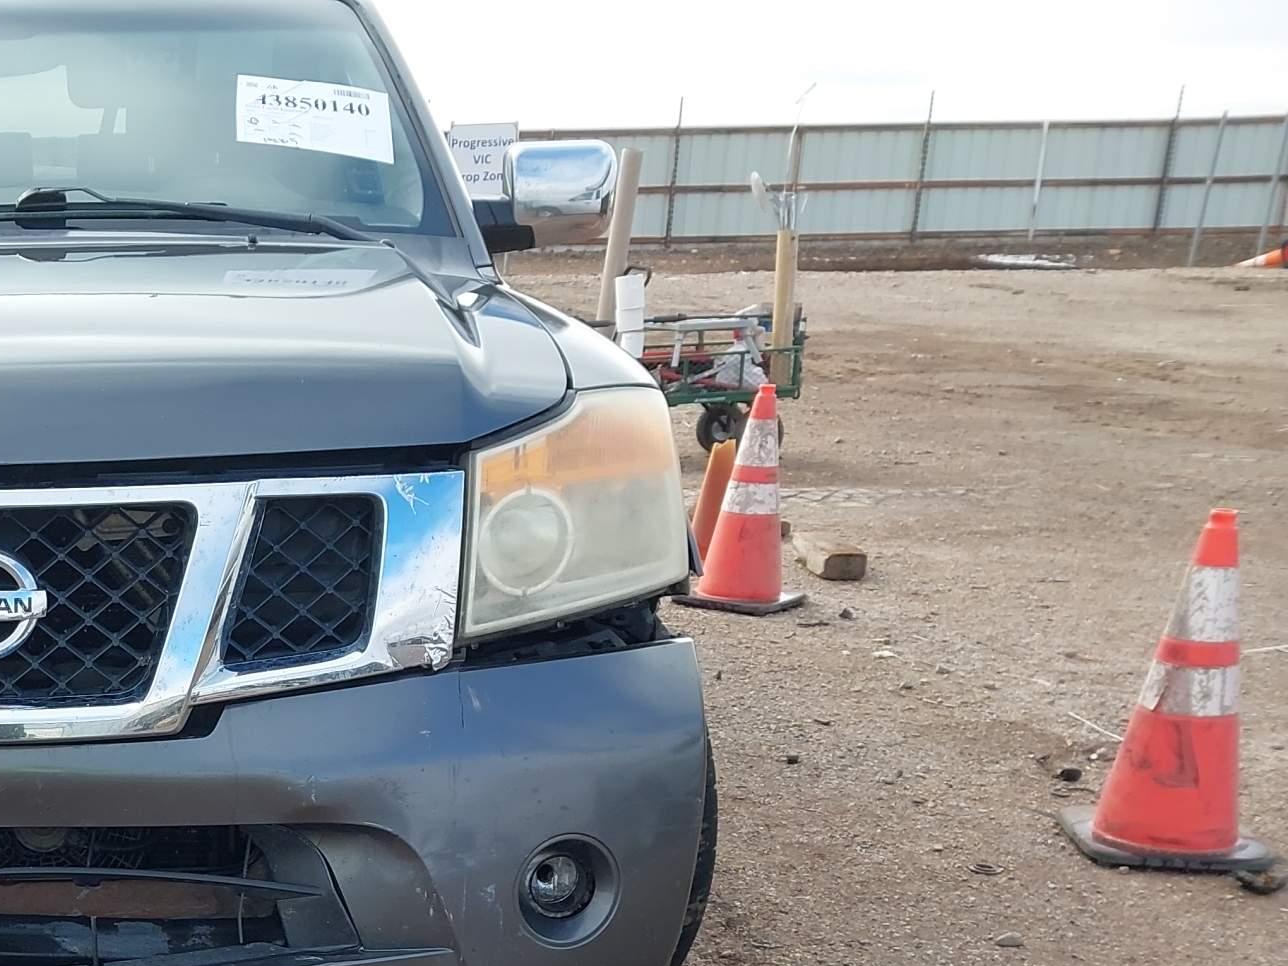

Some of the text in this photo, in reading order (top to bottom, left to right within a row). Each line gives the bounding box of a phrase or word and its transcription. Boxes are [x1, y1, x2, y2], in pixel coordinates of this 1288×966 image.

[255, 93, 371, 117] 43850140
[451, 135, 515, 150] Progressive
[473, 154, 492, 165] VIC
[462, 171, 504, 183] rop Zon
